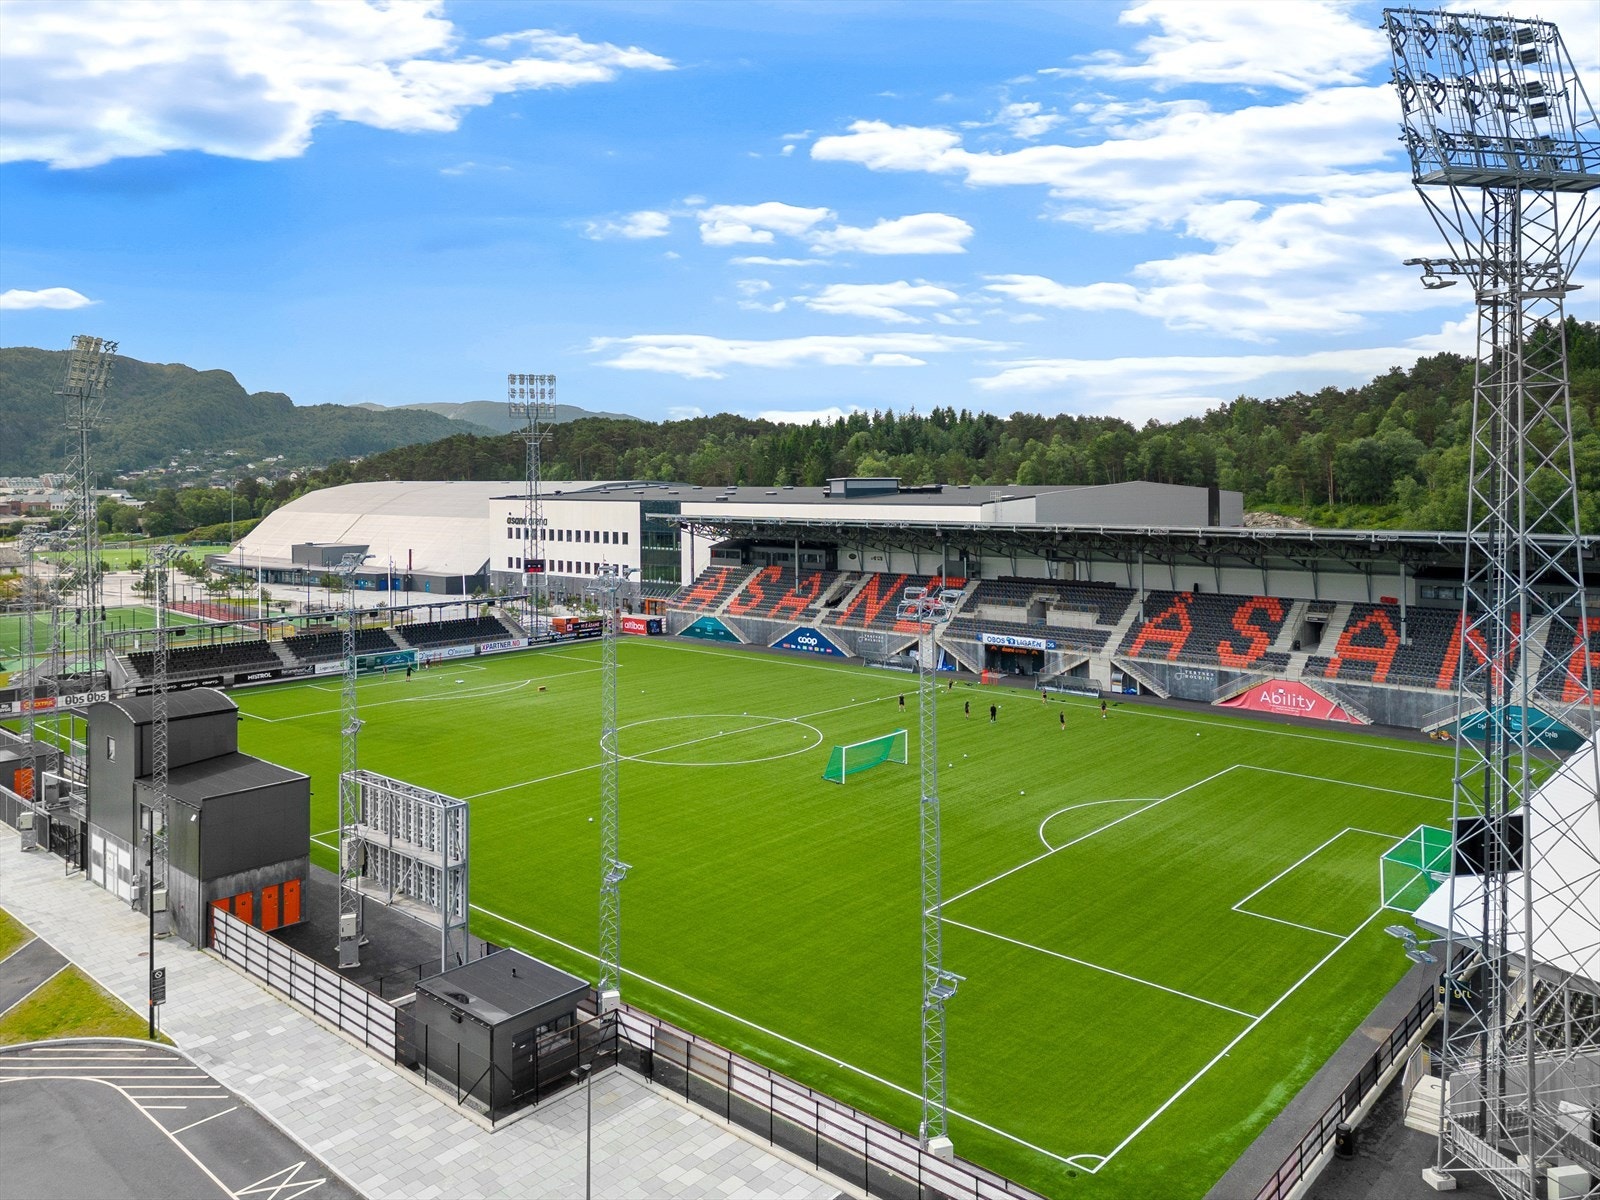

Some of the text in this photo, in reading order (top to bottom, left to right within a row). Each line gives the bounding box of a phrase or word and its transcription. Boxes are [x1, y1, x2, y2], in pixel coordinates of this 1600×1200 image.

[481, 640, 521, 652] XPARTNER.NO
[1016, 640, 1042, 648] LIGAEN
[1260, 690, 1316, 712] Ability
